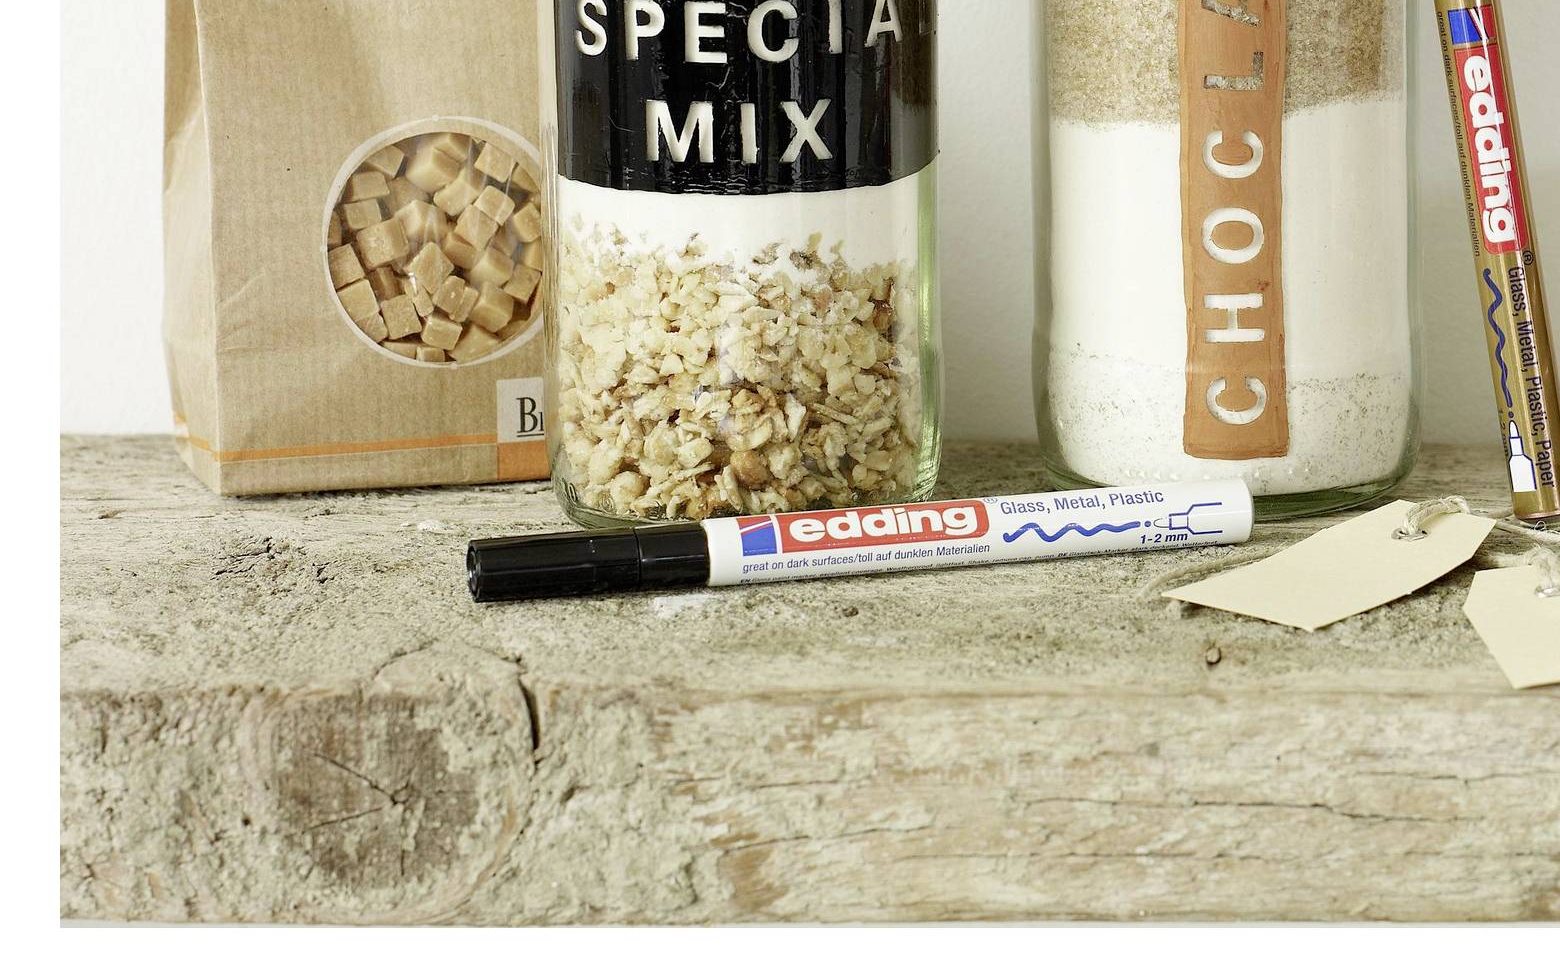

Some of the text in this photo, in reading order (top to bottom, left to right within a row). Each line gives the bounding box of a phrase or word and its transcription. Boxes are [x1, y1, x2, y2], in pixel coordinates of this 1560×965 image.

[1444, 54, 1453, 77] dark
[645, 98, 833, 164] MIX
[1463, 54, 1518, 244] edding
[1508, 265, 1555, 488] Glass, Metal, Plastic, Paper
[1000, 490, 1164, 515] Glass, Metal, Plastic
[788, 505, 979, 543] edding
[1165, 533, 1188, 542] mm
[742, 561, 769, 574] great
[771, 561, 784, 570] on
[787, 558, 809, 568] dark
[876, 550, 892, 561] auf
[894, 547, 933, 560] dunklen
[936, 543, 990, 556] Materialien
